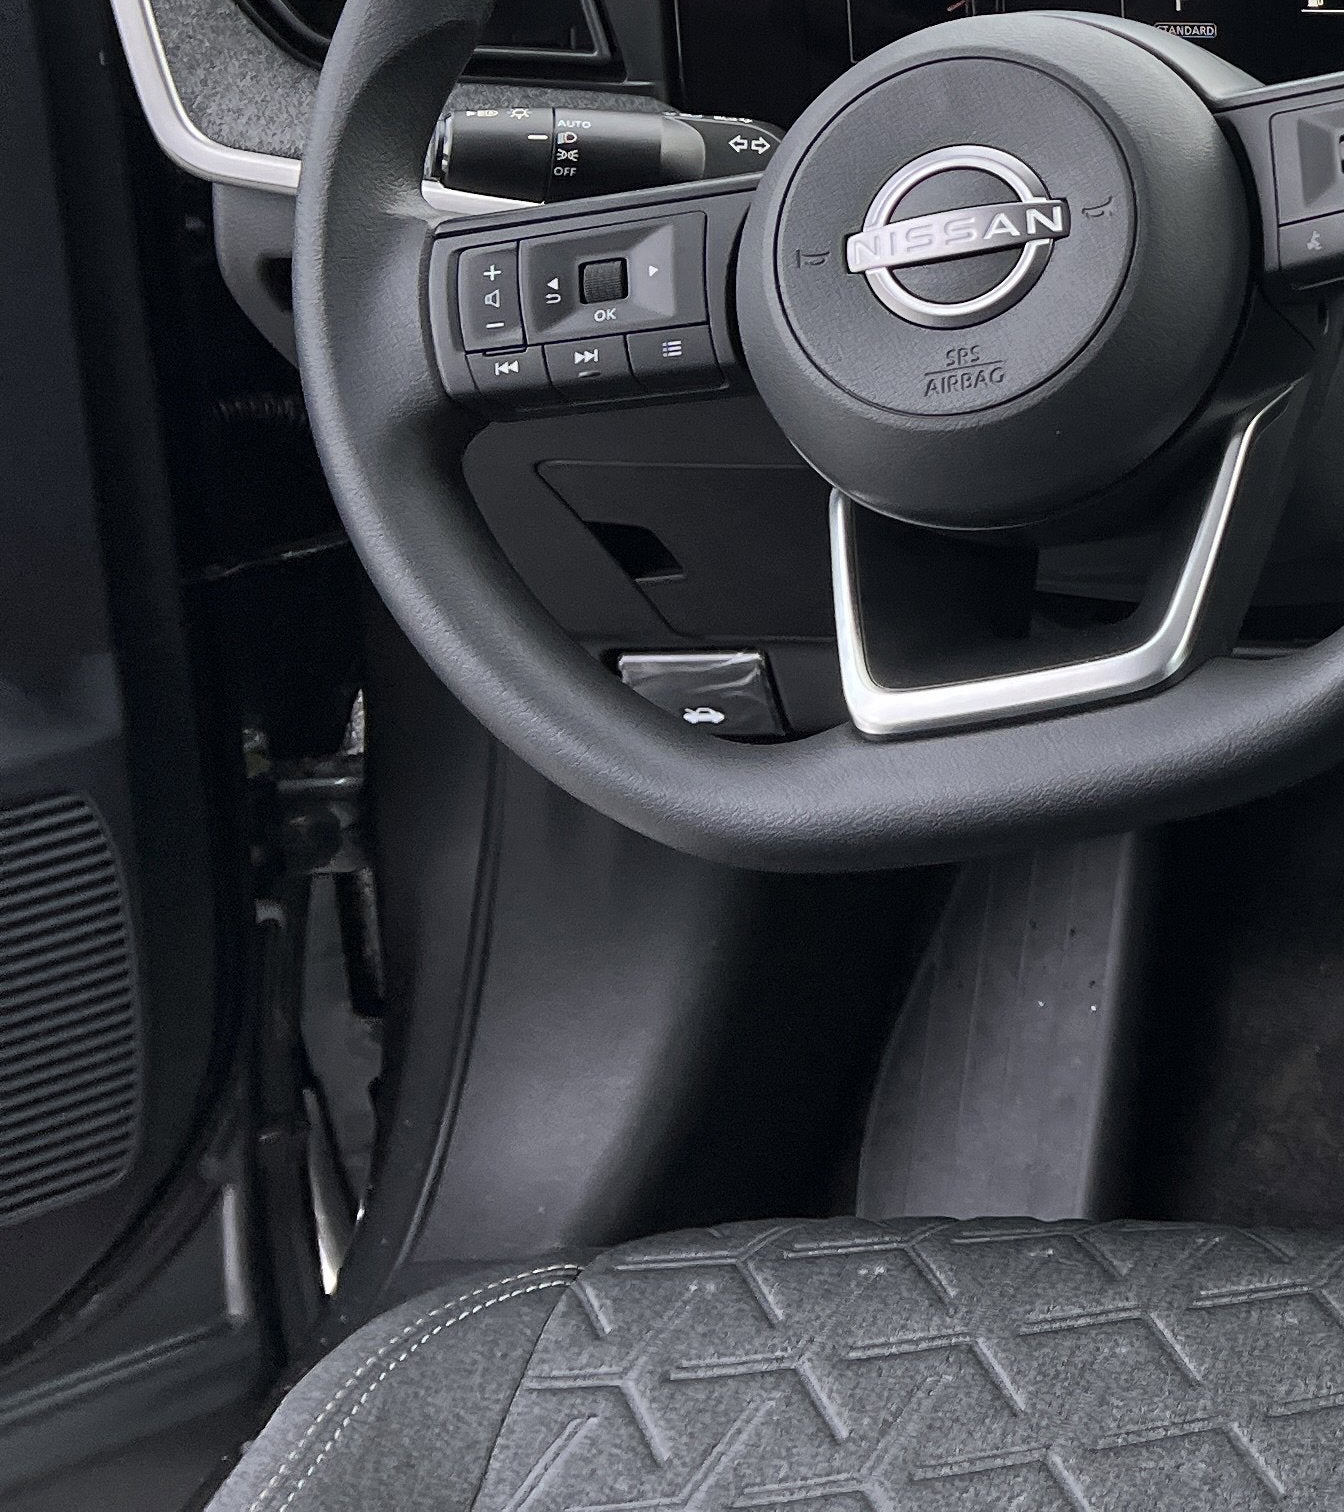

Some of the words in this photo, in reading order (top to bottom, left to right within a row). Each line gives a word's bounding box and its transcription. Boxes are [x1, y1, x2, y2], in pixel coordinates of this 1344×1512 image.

[557, 119, 592, 129] AUTO
[553, 166, 577, 177] OFF
[851, 205, 1064, 266] NISSAN
[593, 308, 617, 322] OK
[945, 344, 981, 367] SRS
[924, 366, 1005, 398] AIRBAG
